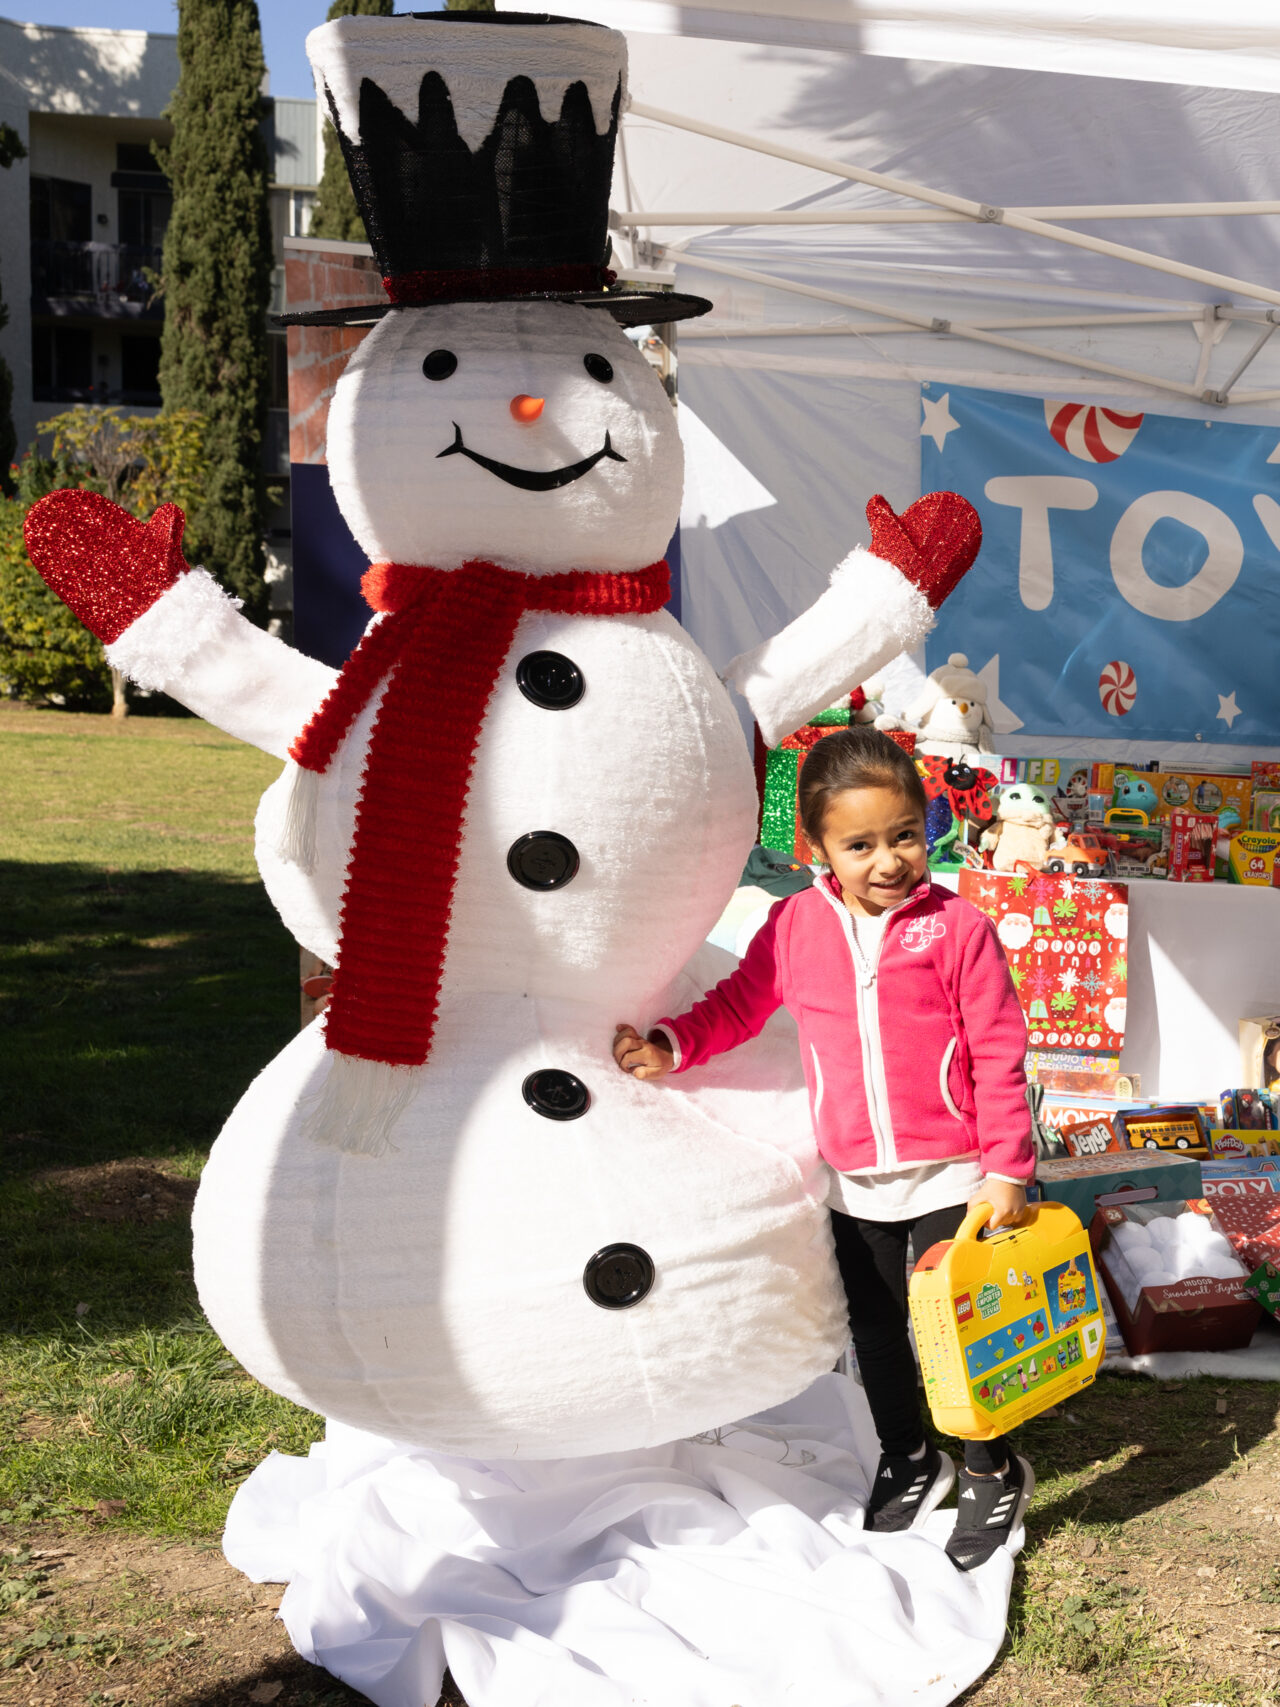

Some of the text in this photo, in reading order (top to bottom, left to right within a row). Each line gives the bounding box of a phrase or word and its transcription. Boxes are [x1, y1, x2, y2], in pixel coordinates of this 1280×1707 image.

[1004, 760, 1058, 783] LIFE
[1241, 835, 1277, 846] Crayola
[1250, 859, 1264, 870] 64
[1243, 871, 1271, 881] CRAYONS
[1069, 1123, 1112, 1157] Jenga
[1183, 1278, 1214, 1287] INDOOR
[1163, 1281, 1243, 1299] Snowball Fight
[957, 1300, 971, 1315] LEGO
